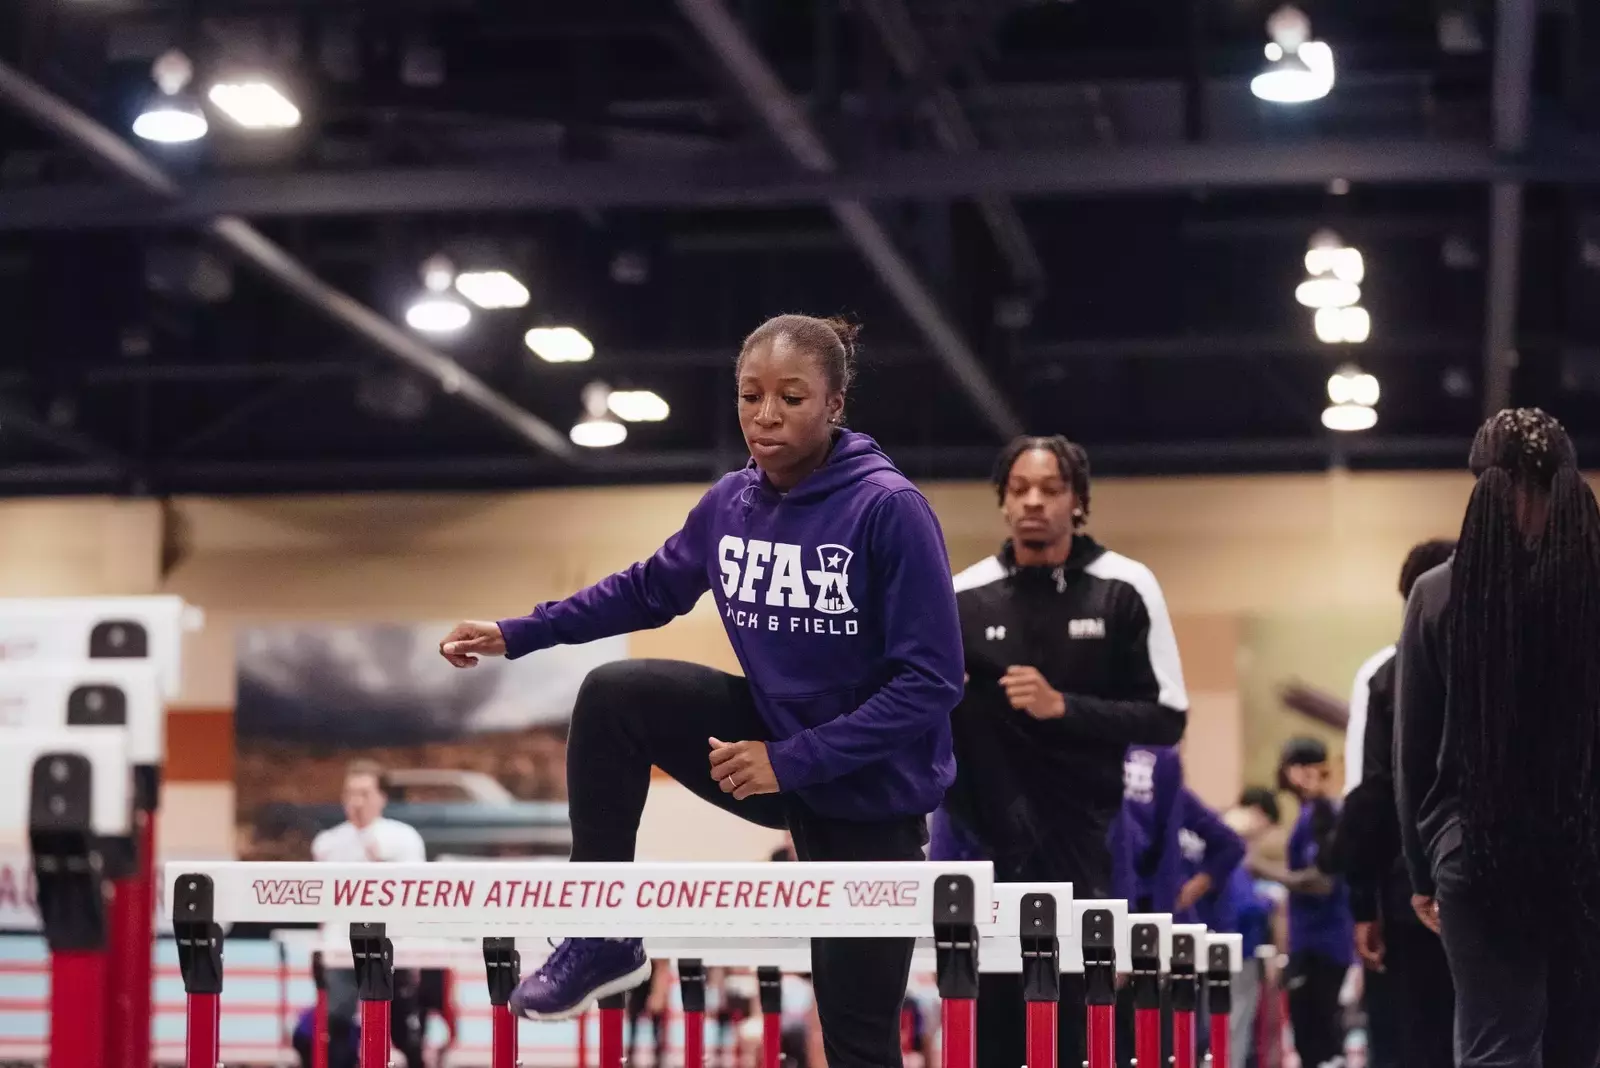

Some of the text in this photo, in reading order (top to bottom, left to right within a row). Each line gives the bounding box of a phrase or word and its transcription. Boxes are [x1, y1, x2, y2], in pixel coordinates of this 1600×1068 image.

[718, 534, 810, 608] SFA
[768, 616, 779, 631] &
[790, 617, 858, 635] FIELD
[252, 880, 919, 908] WAC WESTERN ATHLETIC CONFERENCE WAC
